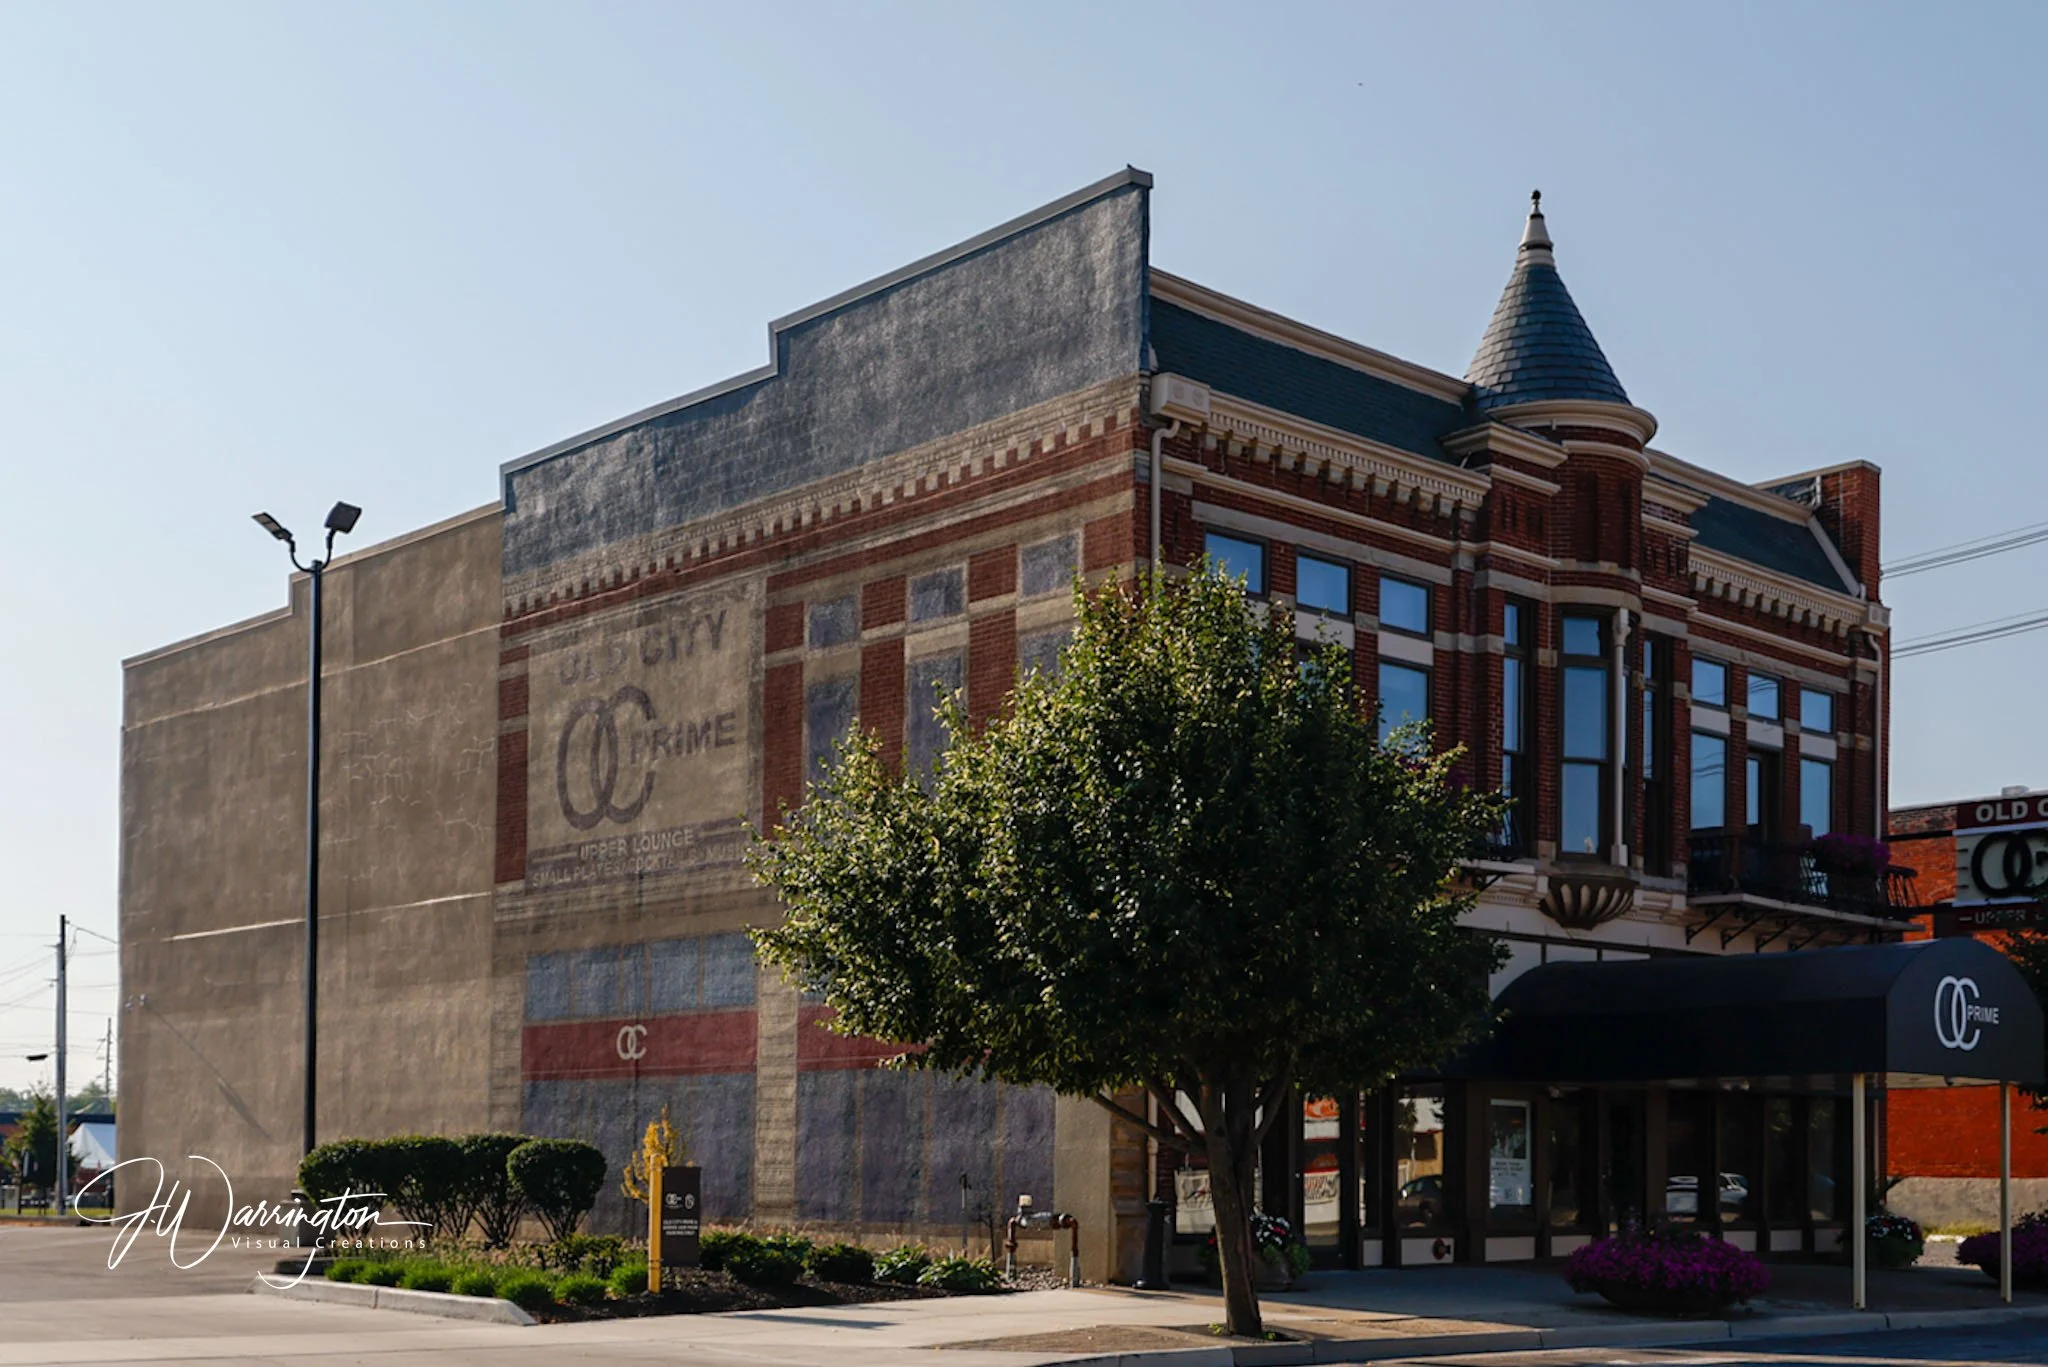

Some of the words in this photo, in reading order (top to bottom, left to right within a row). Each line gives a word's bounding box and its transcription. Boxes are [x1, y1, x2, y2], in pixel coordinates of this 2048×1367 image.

[560, 641, 627, 685] OLD
[640, 609, 728, 666] CITY
[630, 712, 736, 765] PRIME
[1975, 800, 2029, 823] OLD
[580, 839, 629, 860] UPPER
[633, 829, 694, 853] LOUNGE
[533, 868, 571, 888] SMALL
[1967, 1005, 1999, 1025] PRIME
[616, 1024, 648, 1060] OC
